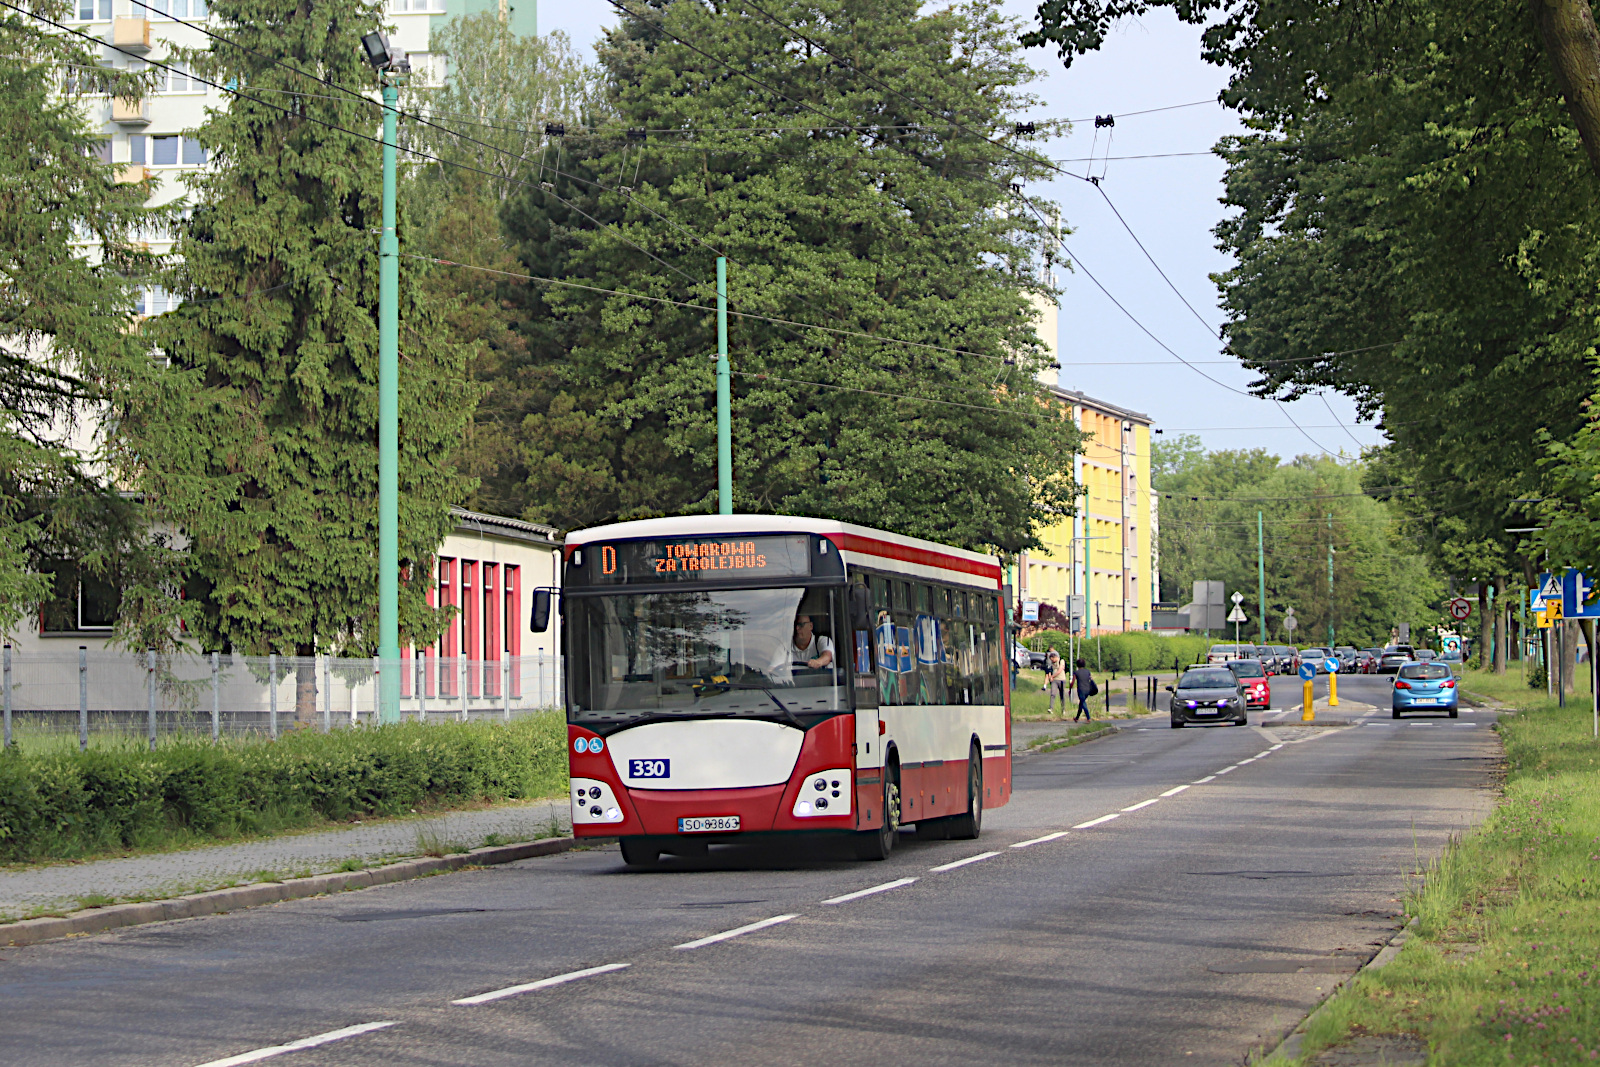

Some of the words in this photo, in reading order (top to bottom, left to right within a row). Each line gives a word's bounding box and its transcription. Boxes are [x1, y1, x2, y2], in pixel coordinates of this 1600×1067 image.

[665, 541, 756, 558] TOWAROWA
[601, 545, 617, 575] D
[655, 558, 677, 573] ZA
[680, 554, 767, 572] TROLEJBUS
[633, 760, 665, 777] 330
[685, 819, 701, 830] SO
[704, 817, 738, 829] 83863
